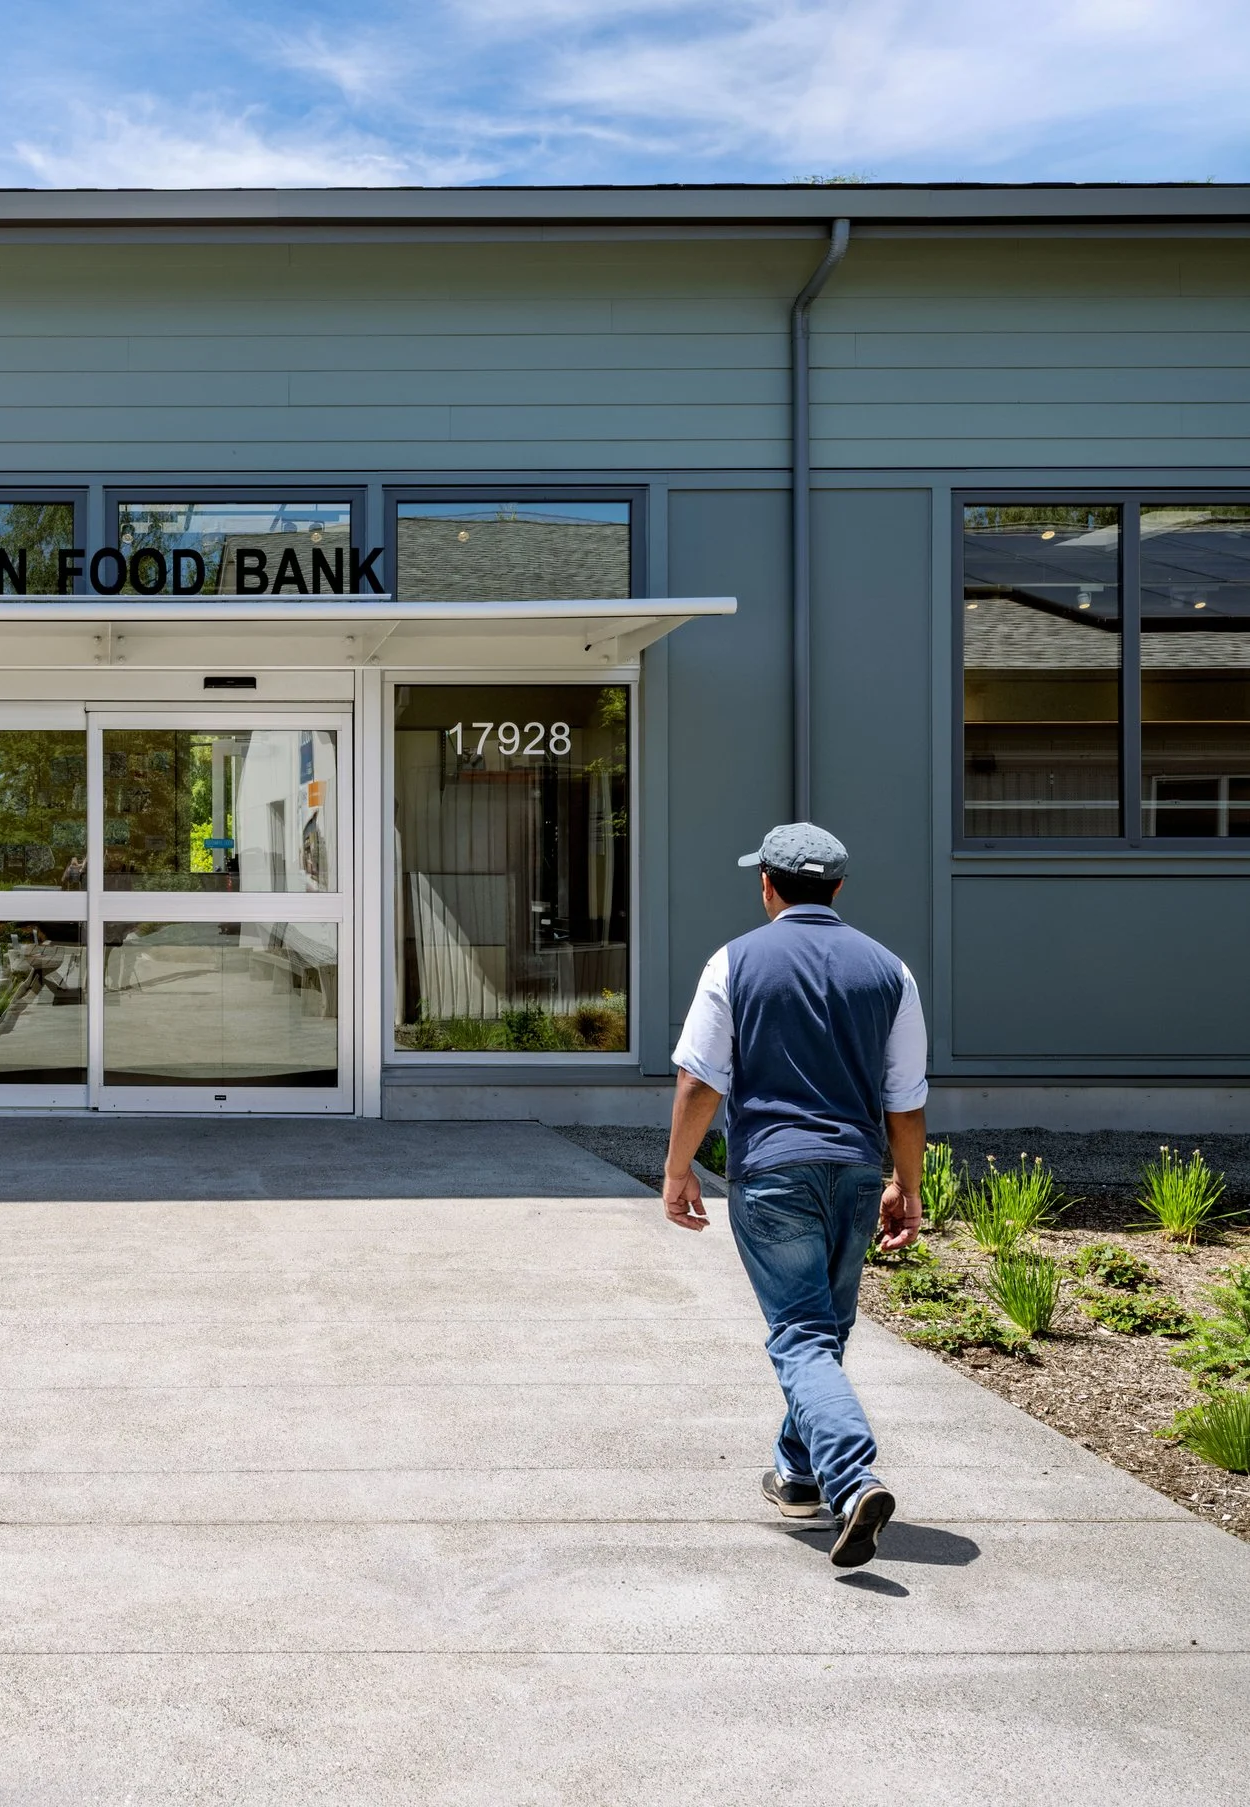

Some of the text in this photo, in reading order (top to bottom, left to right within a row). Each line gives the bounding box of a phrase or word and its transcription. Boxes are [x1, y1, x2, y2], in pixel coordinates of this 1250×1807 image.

[57, 547, 206, 595] FOOD
[236, 547, 386, 595] BANK
[449, 721, 572, 755] 17928
